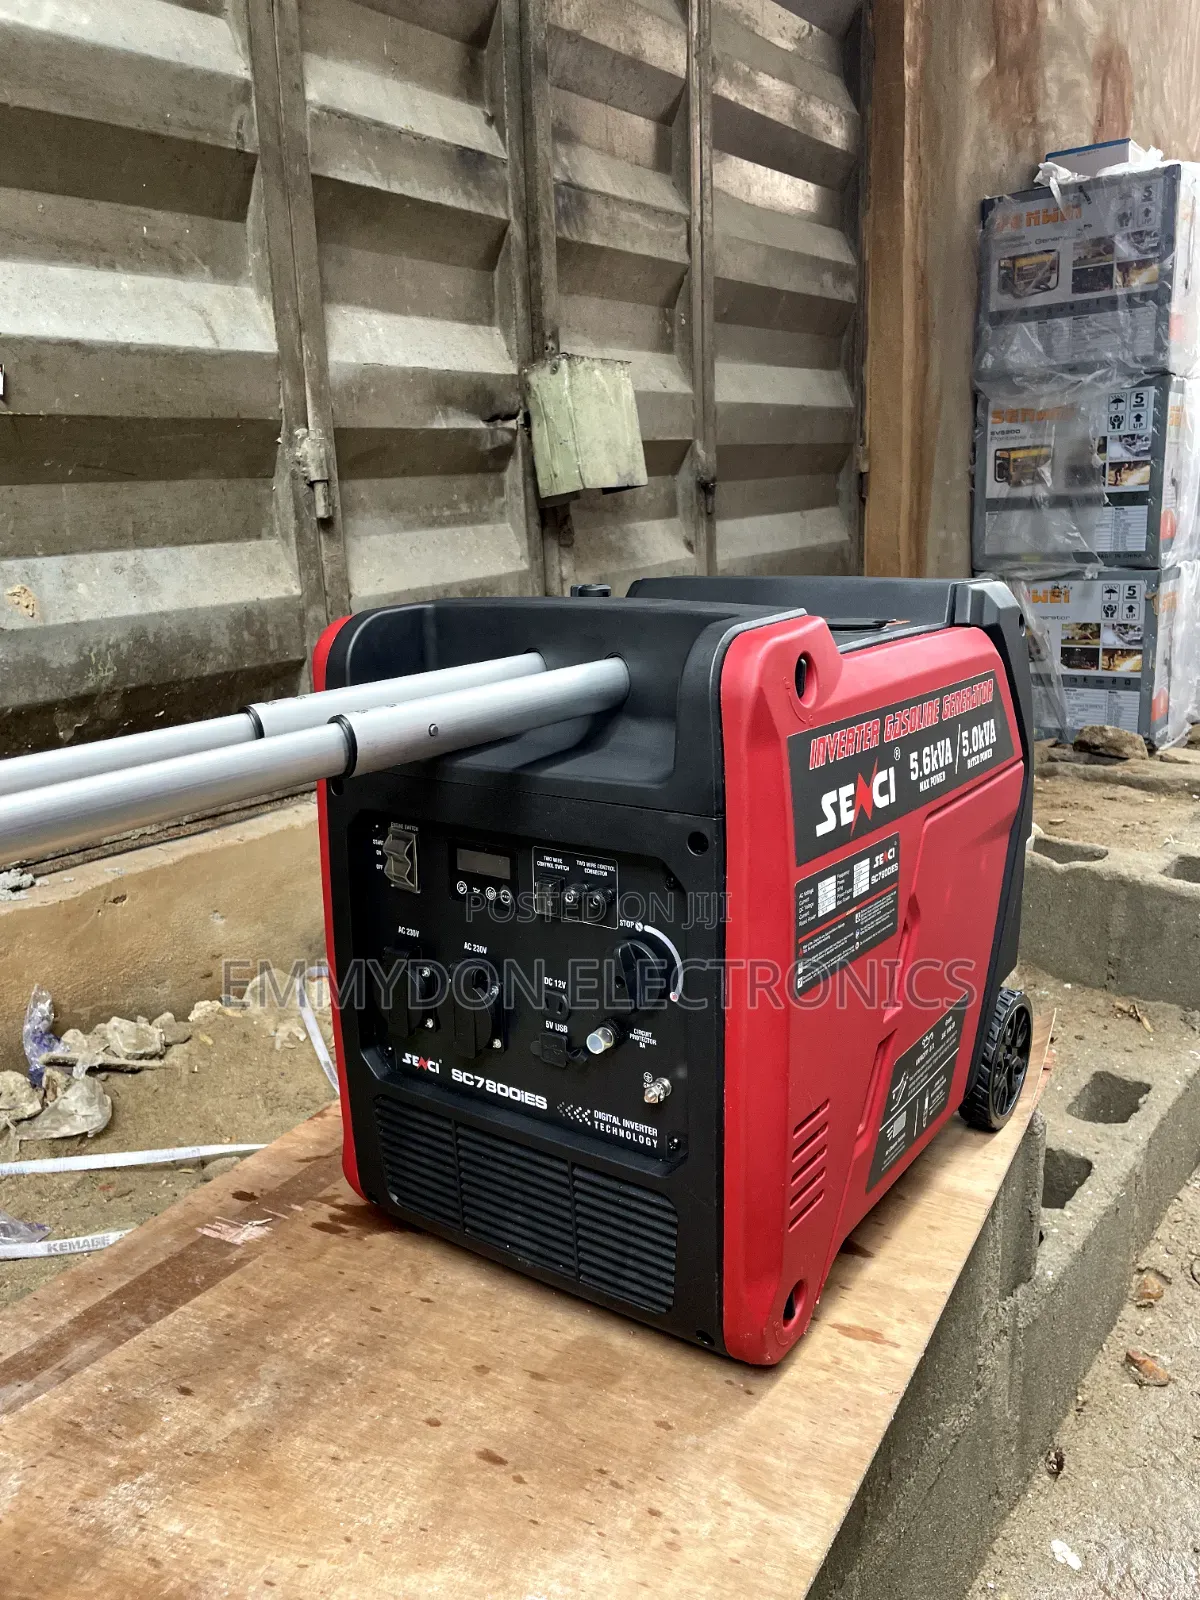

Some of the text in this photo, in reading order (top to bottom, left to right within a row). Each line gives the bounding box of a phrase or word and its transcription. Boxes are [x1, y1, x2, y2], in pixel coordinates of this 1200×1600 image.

[1135, 392, 1144, 404] 5
[991, 404, 1076, 424] SENW
[1030, 588, 1070, 603] WEI
[1127, 585, 1137, 596] 5
[808, 678, 994, 771] INVERTER GASOLINE GENERATOR
[909, 737, 953, 781] 5.6kVA
[961, 719, 997, 757] 5.0kVA
[979, 748, 993, 763] POWER
[919, 770, 946, 793] MAX POWER
[815, 755, 896, 838] SENCI
[873, 847, 895, 869] SENCI
[536, 860, 570, 872] CONTROL SWITCH
[576, 859, 616, 872] TWO WIRE CONTROL
[584, 868, 608, 877] CONNECTOR
[619, 919, 635, 929] STOP
[398, 925, 420, 938] AC 230V
[463, 941, 488, 955] AC 230V
[543, 976, 567, 990] DC 12V
[555, 1023, 568, 1034] USB
[633, 1028, 653, 1038] CIRCUIT
[629, 1033, 657, 1046] PROTECTOR
[402, 1052, 440, 1074] SENCI
[451, 1068, 548, 1110] SC7800iES
[593, 1110, 658, 1138] DIGITAL INVERTER
[593, 1120, 658, 1149] TECHNOLOGY
